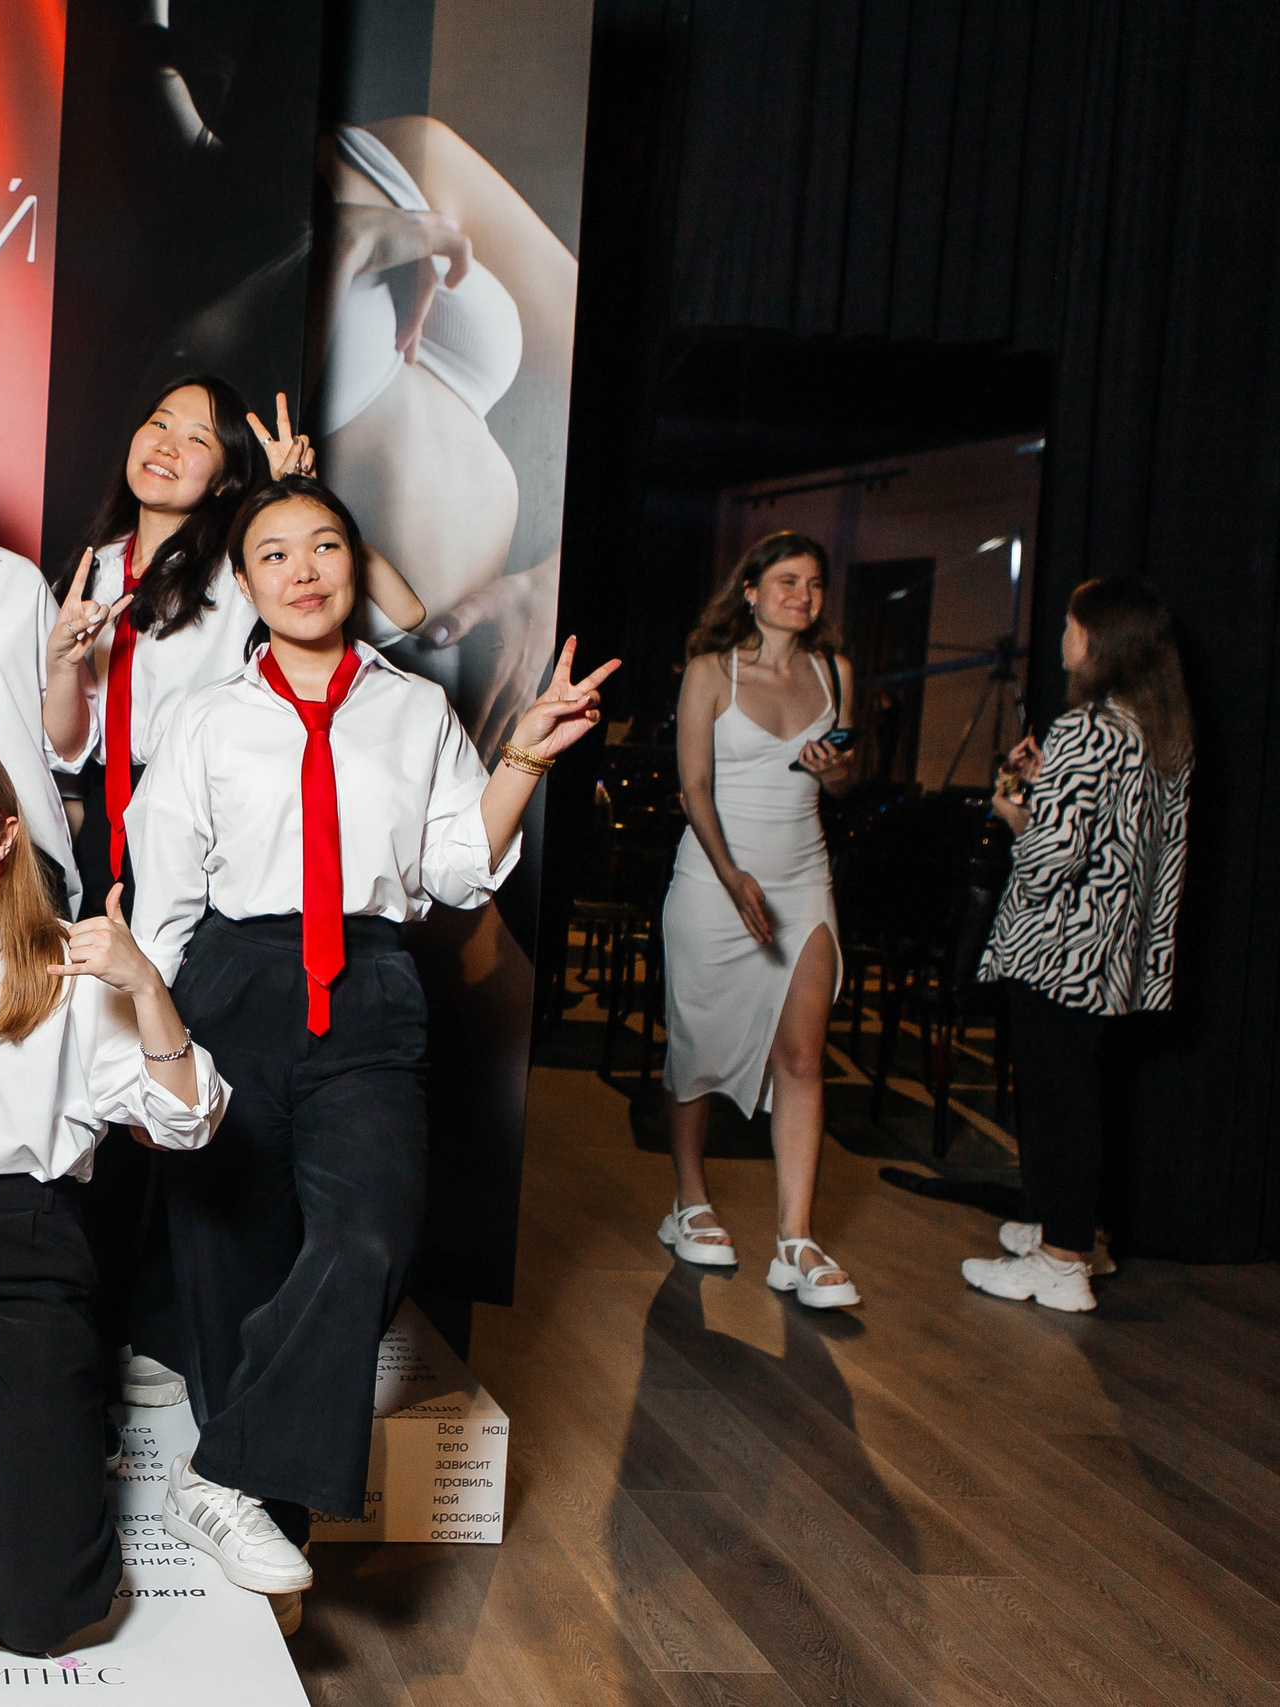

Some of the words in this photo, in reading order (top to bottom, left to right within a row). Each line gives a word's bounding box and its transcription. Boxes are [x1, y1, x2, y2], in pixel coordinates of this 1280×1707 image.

[438, 1422, 465, 1435] Все
[436, 1442, 469, 1453] тело
[435, 1460, 492, 1471] зависит
[433, 1477, 494, 1490] правиль
[433, 1493, 460, 1505] ной
[431, 1512, 501, 1525] красивой
[431, 1530, 486, 1541] осанки.
